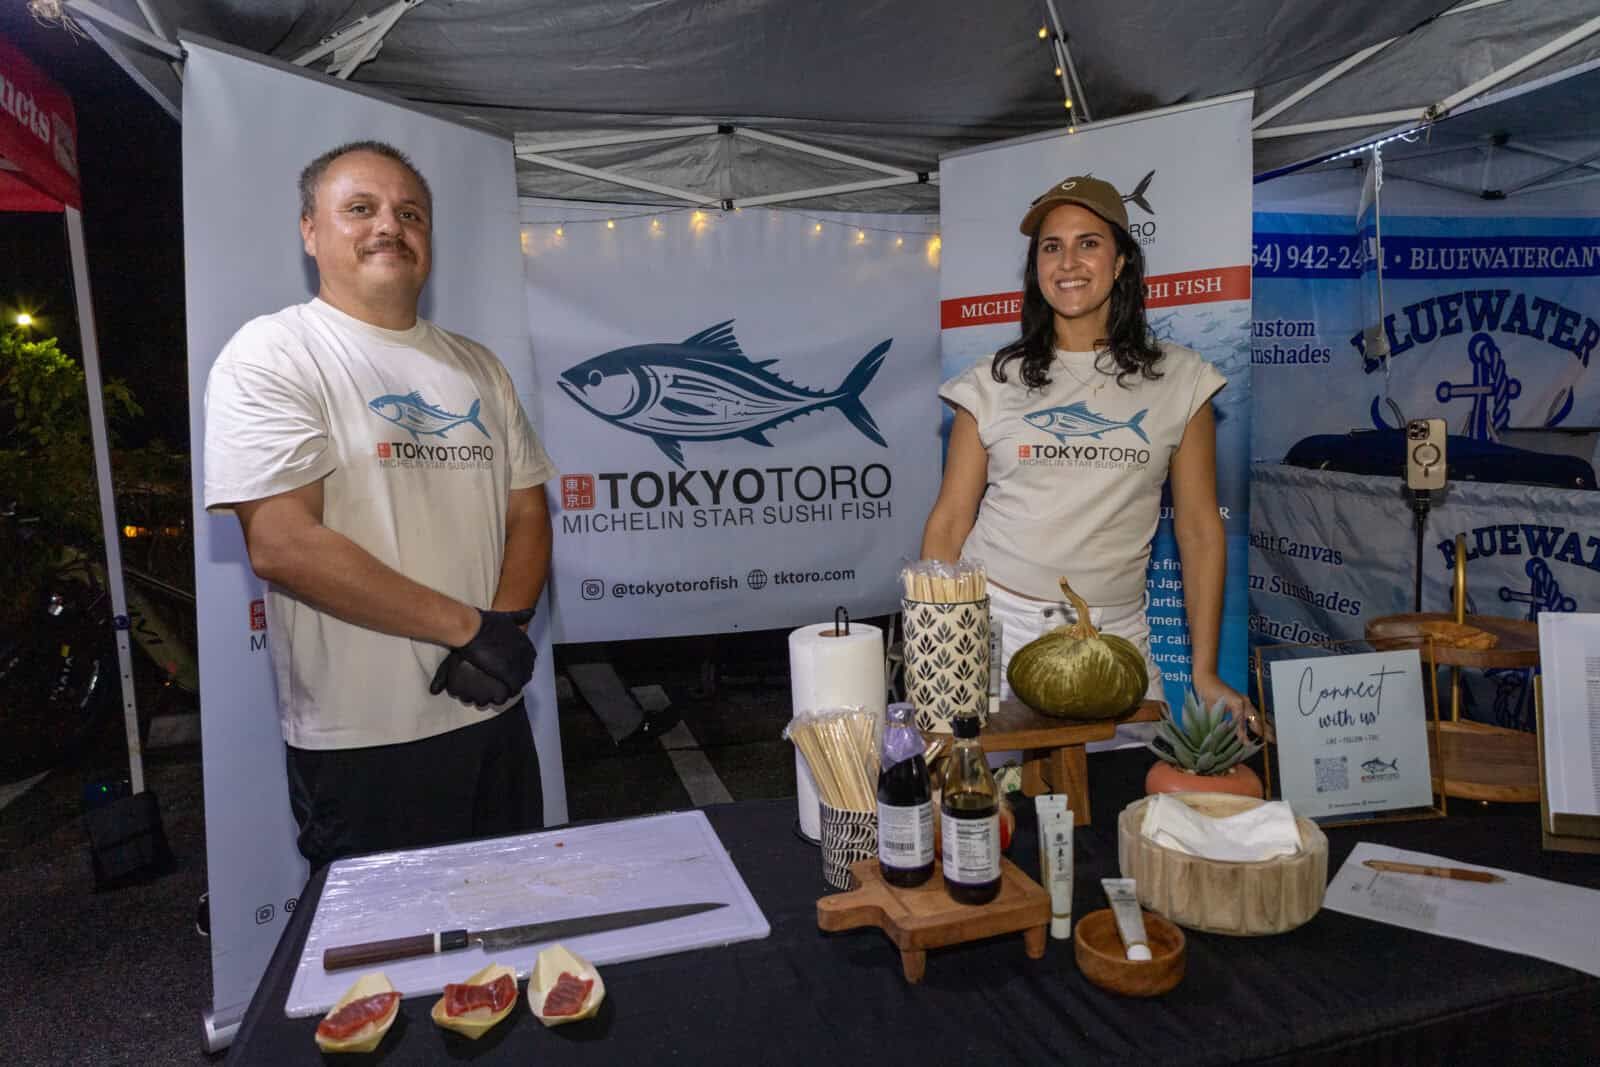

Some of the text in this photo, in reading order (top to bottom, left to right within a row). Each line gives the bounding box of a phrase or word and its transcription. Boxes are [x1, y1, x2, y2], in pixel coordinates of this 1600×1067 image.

[1174, 276, 1222, 296] FISH
[391, 442, 495, 462] TOKYOTORO
[1031, 445, 1151, 465] TOKYOTORO
[598, 463, 892, 510] TOKYOTORO
[562, 500, 892, 535] MICHELIN STAR SUSHI FISH
[1278, 536, 1343, 566] Canvas
[611, 567, 856, 599] @tokyotorofish tktoro.com
[1269, 575, 1361, 616] Sunshades
[1152, 596, 1185, 608] artis
[1297, 664, 1408, 717] Connect
[1318, 708, 1377, 729] with us
